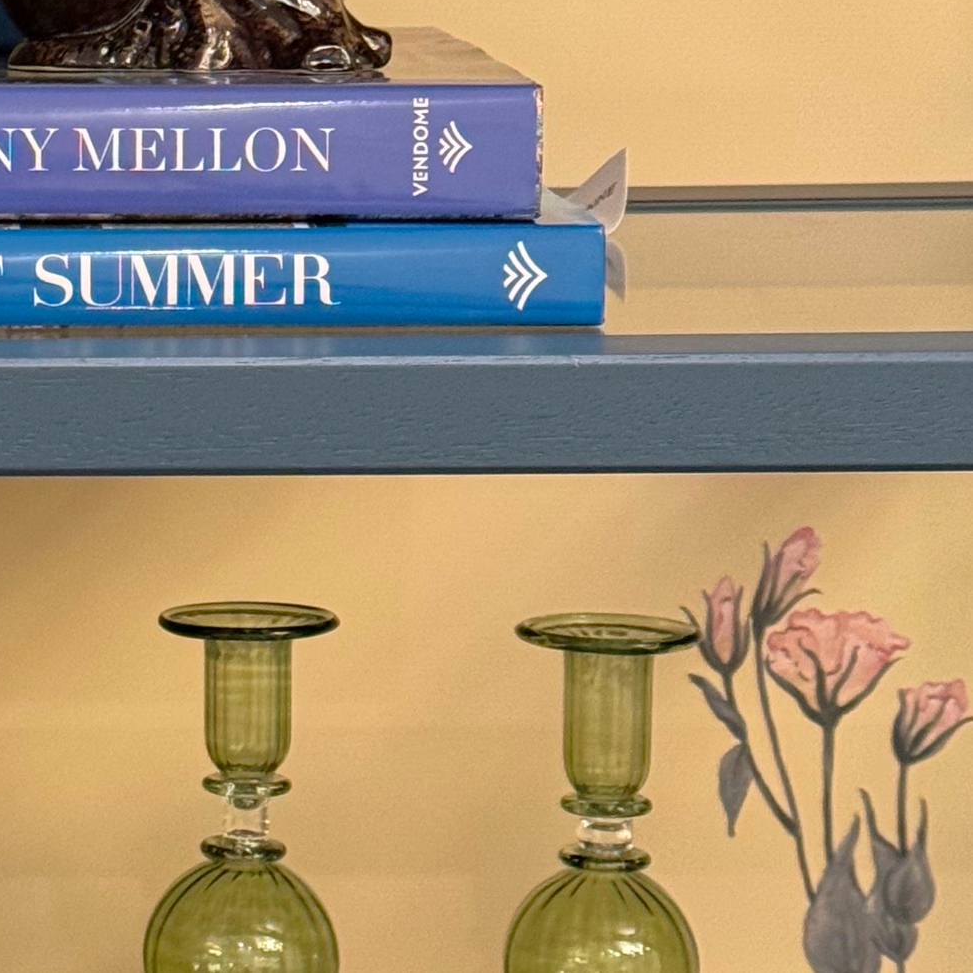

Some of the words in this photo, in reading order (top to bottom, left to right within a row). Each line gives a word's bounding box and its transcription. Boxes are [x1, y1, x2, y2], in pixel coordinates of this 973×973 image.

[72, 126, 337, 173] MELLON
[412, 97, 430, 197] VENDOME
[33, 254, 341, 309] SUMMER
